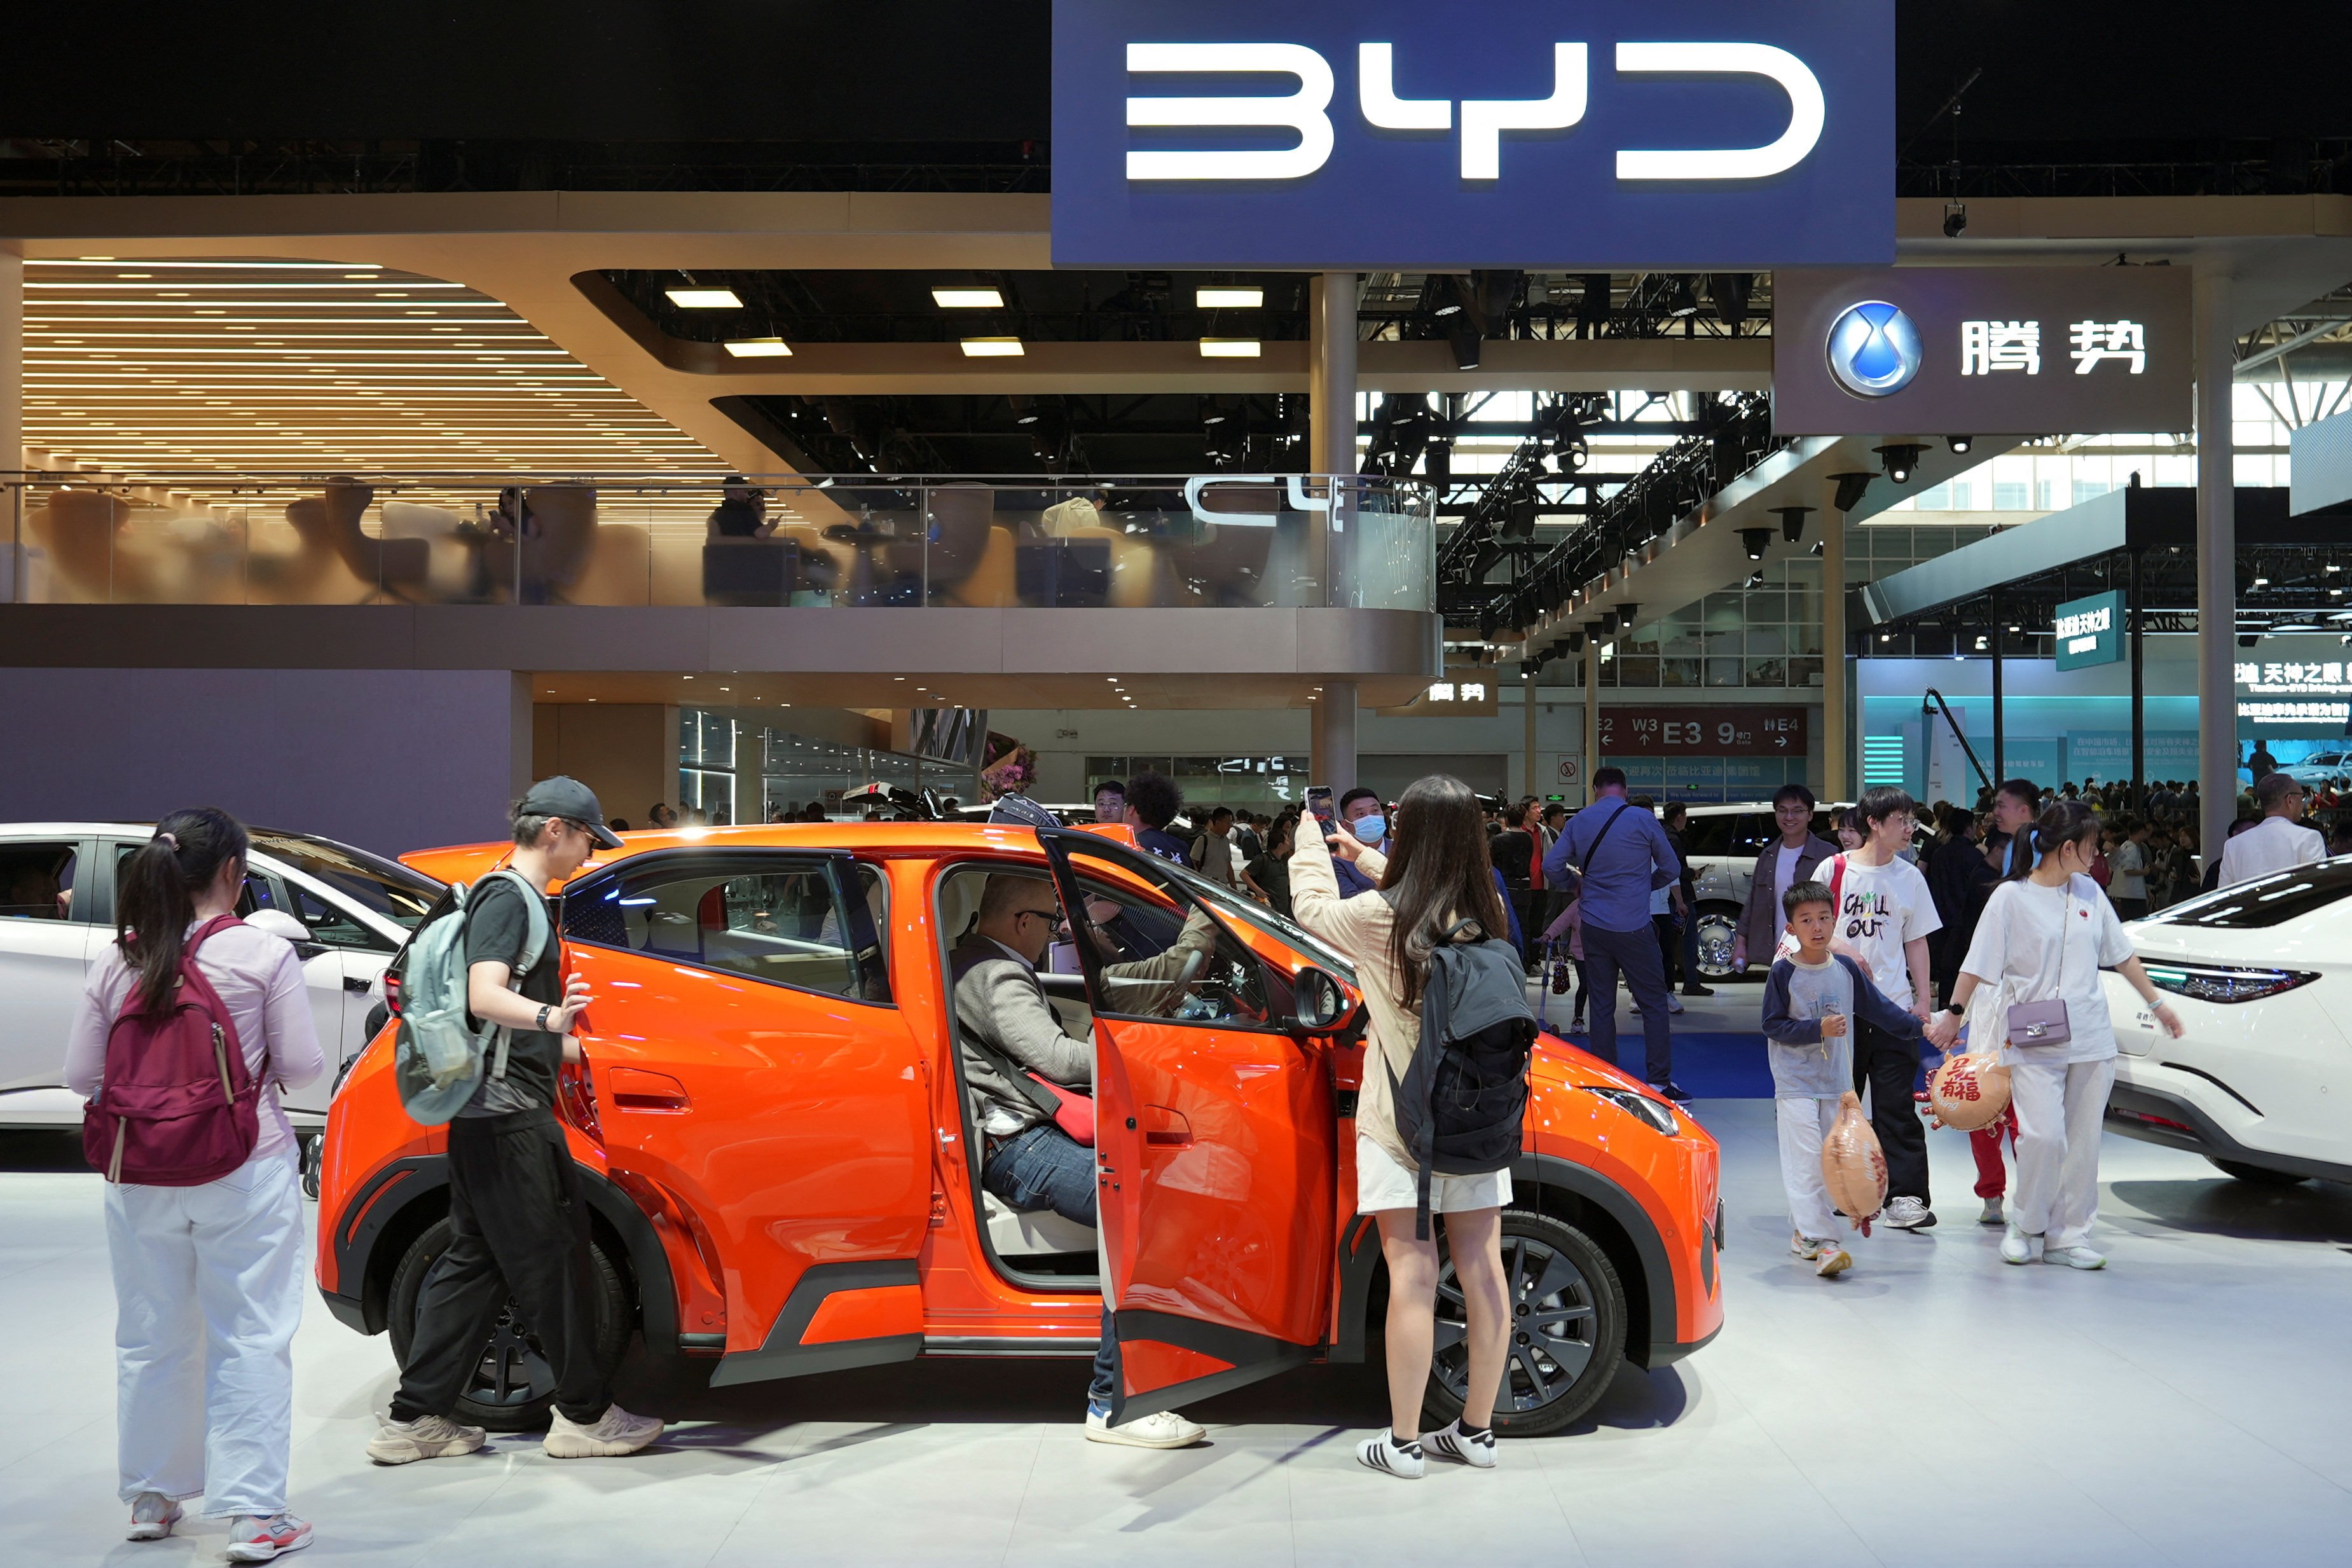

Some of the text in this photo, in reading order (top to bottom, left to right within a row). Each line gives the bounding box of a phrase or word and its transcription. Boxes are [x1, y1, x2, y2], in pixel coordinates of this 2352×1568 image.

[1126, 42, 1825, 179] BYD
[1961, 320, 2146, 376] 腾势
[1632, 719, 1658, 731] W3
[1663, 722, 1702, 745] E3
[1778, 719, 1799, 731] E4
[1846, 919, 1883, 942] OUT
[1946, 1057, 1977, 1082] 马上
[1934, 1085, 1960, 1111] Blessing
[1941, 1078, 1981, 1101] 有福
